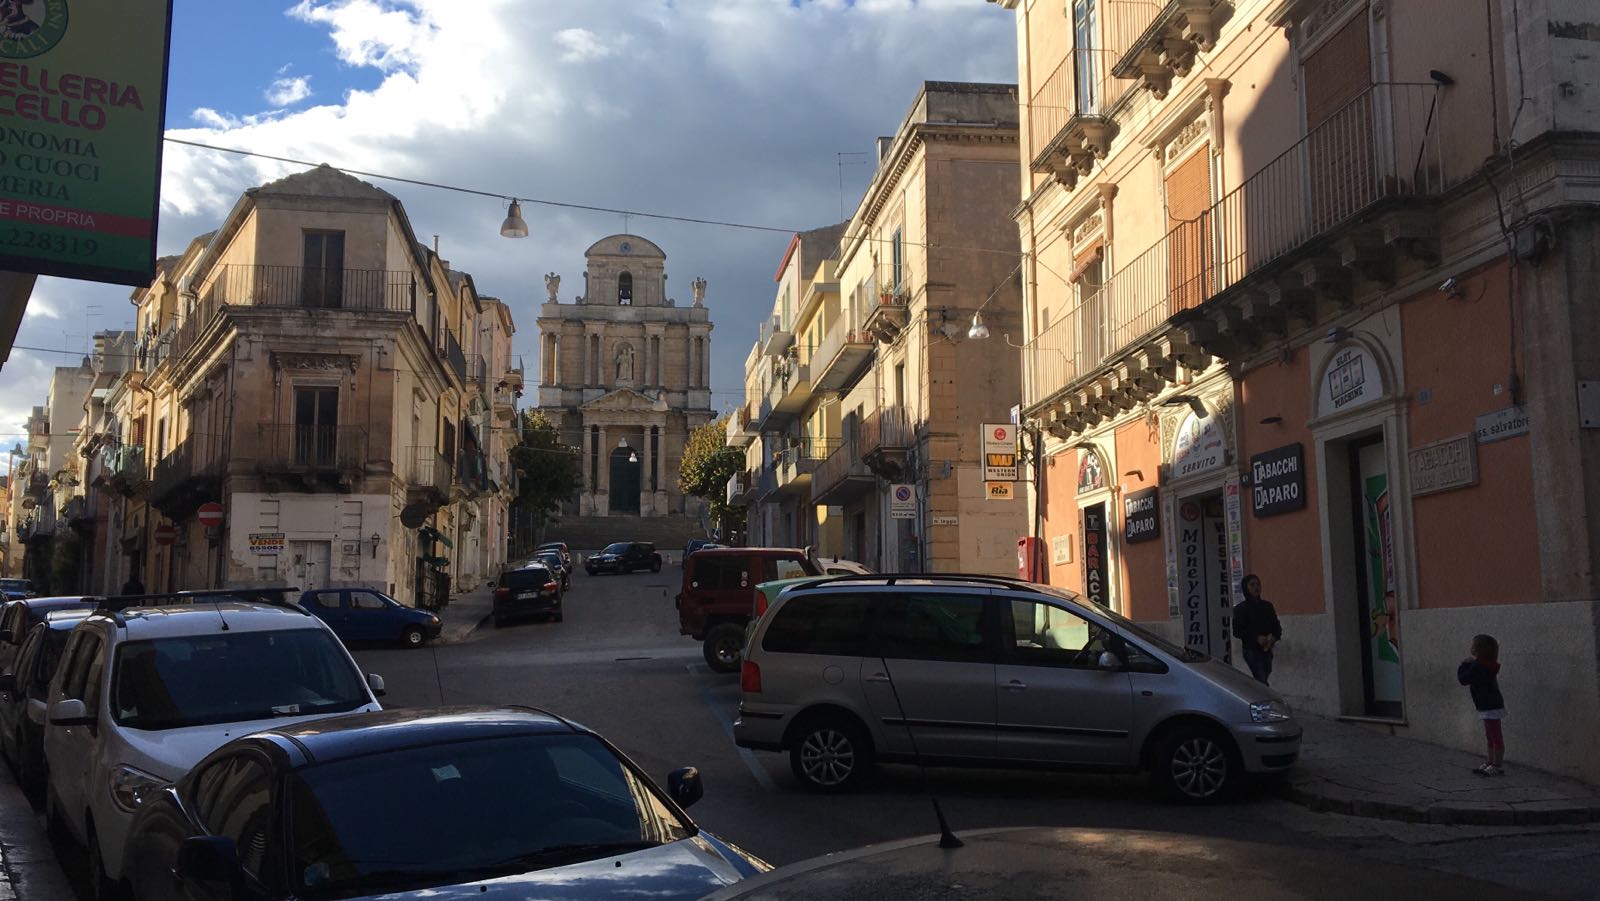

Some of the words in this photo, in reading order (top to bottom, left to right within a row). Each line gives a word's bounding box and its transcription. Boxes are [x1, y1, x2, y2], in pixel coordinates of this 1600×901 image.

[15, 153, 100, 182] CUOCI
[16, 204, 96, 227] PROPRIA
[1335, 386, 1364, 409] MACHINE
[1182, 456, 1217, 475] SERVITO
[1253, 456, 1298, 484] TABACCHI
[991, 485, 1008, 495] Ria
[1254, 482, 1299, 510] DAPARO
[1125, 496, 1154, 518] TABACCHI
[1126, 517, 1155, 538] DAPARO
[1182, 529, 1205, 646] MoneyGram
